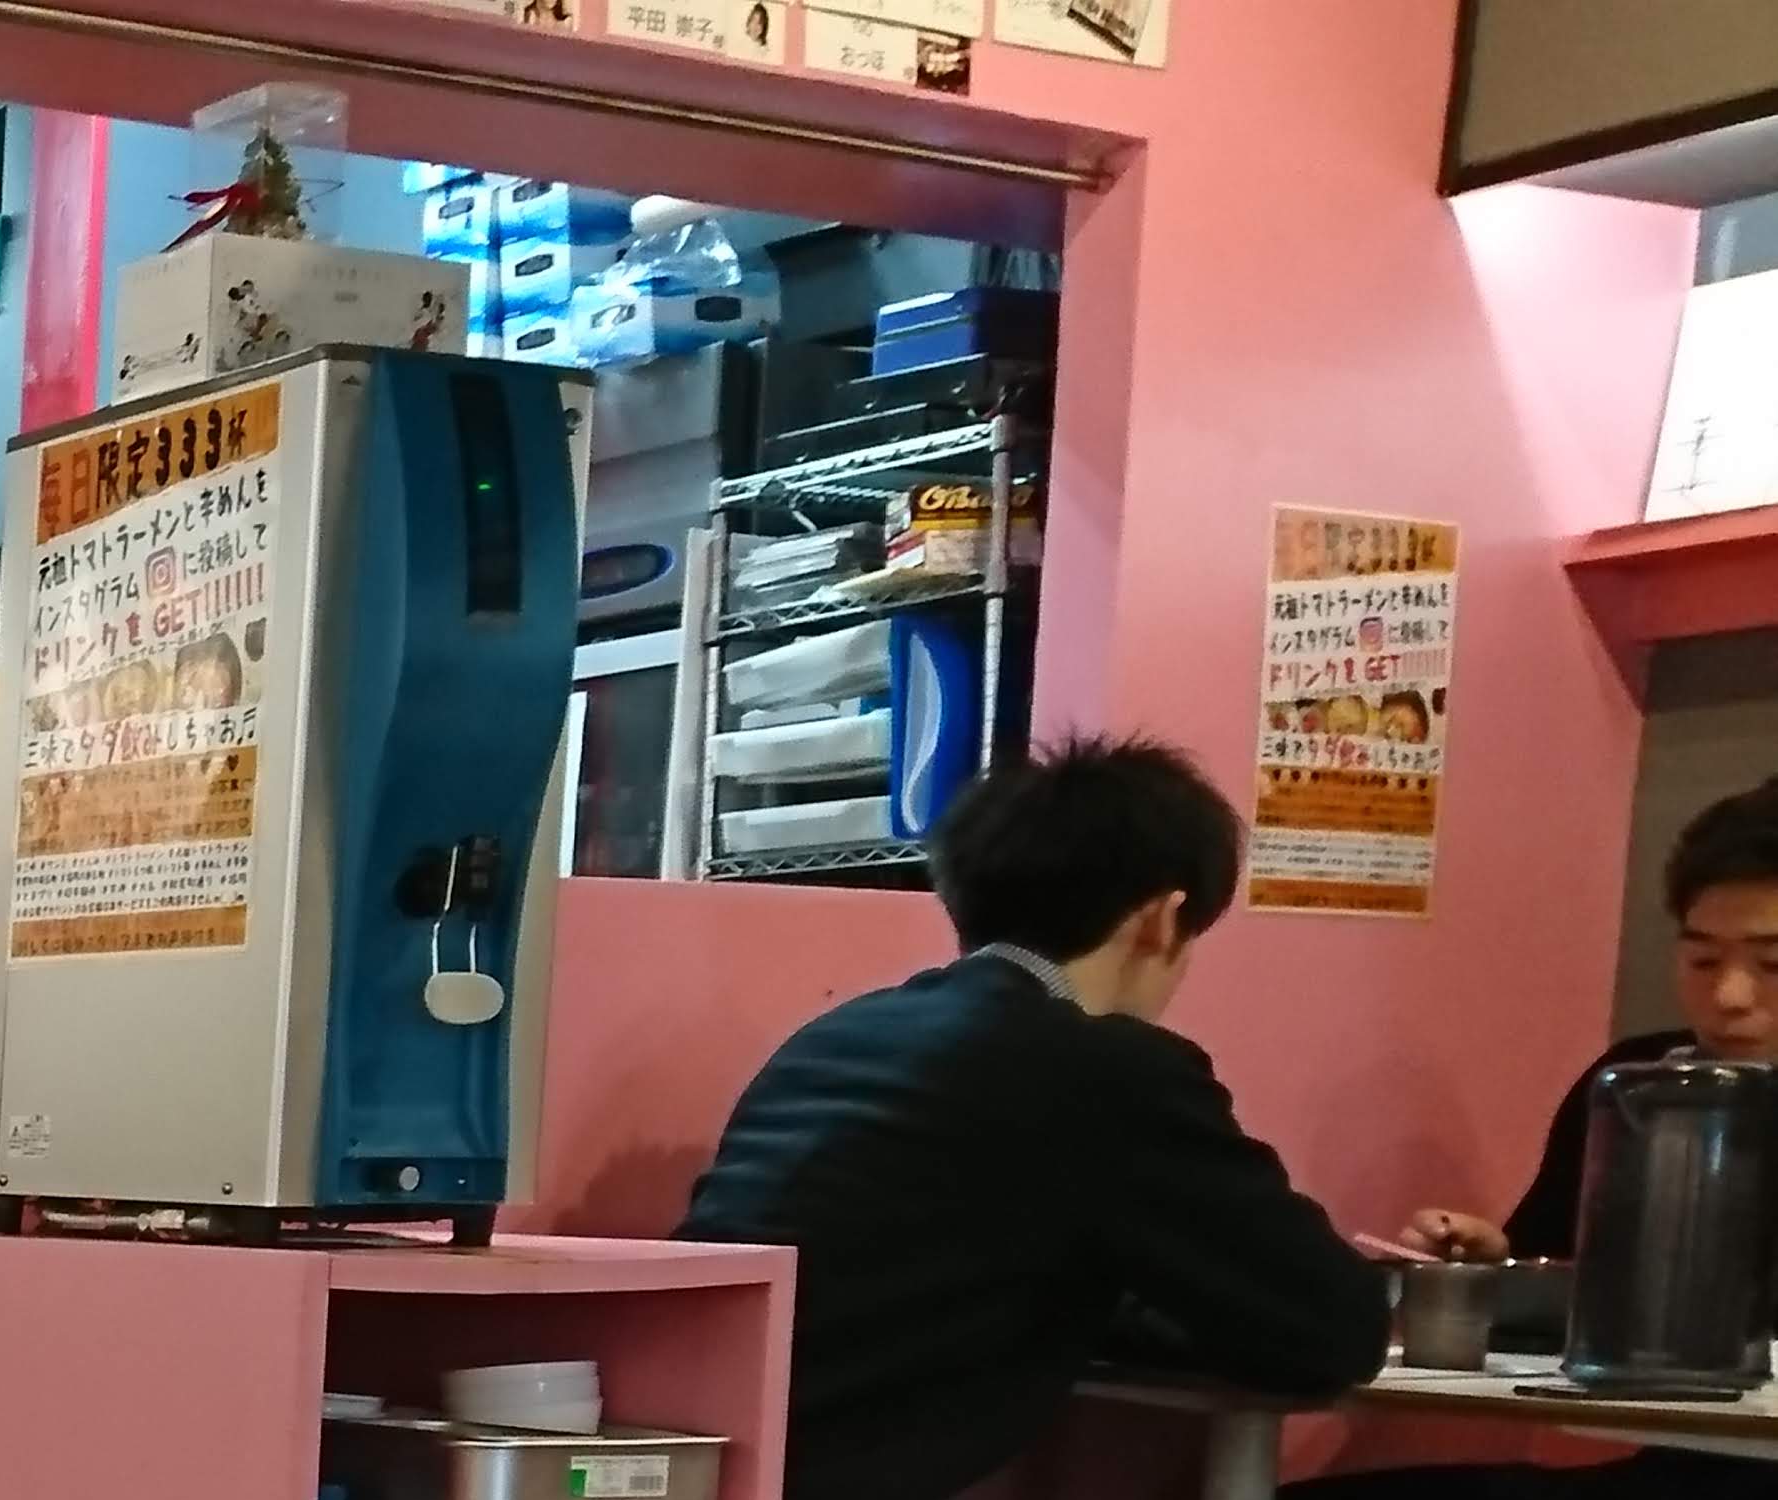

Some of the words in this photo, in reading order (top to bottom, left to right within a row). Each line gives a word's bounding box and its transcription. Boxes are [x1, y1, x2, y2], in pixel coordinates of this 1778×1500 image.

[628, 6, 667, 34] 平田
[36, 467, 269, 593] 元祖トマトラーメンと辛めんを
[39, 407, 247, 538] 毎日限定333杯
[33, 571, 141, 637] インスタグラム
[183, 522, 269, 578] に投稿して
[35, 611, 143, 684] ドリンクを
